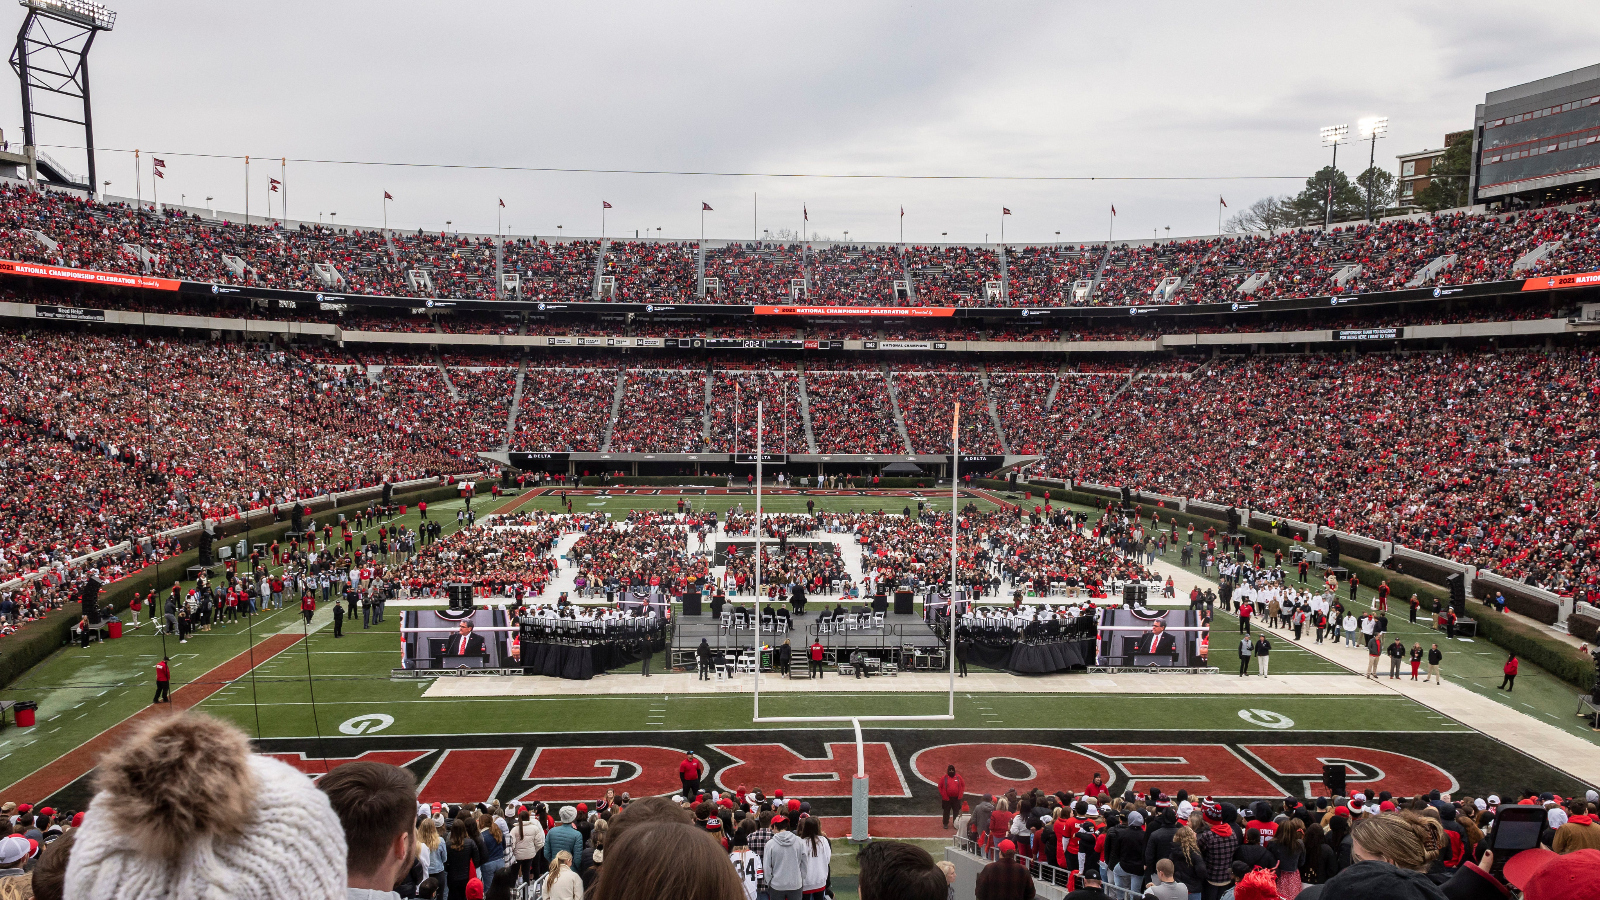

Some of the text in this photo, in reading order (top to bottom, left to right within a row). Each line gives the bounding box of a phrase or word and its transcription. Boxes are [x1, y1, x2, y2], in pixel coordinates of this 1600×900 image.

[15, 266, 47, 275] NATIONAL
[49, 270, 95, 280] CHAMPIONSHIP
[96, 275, 136, 285] CELEBRATION
